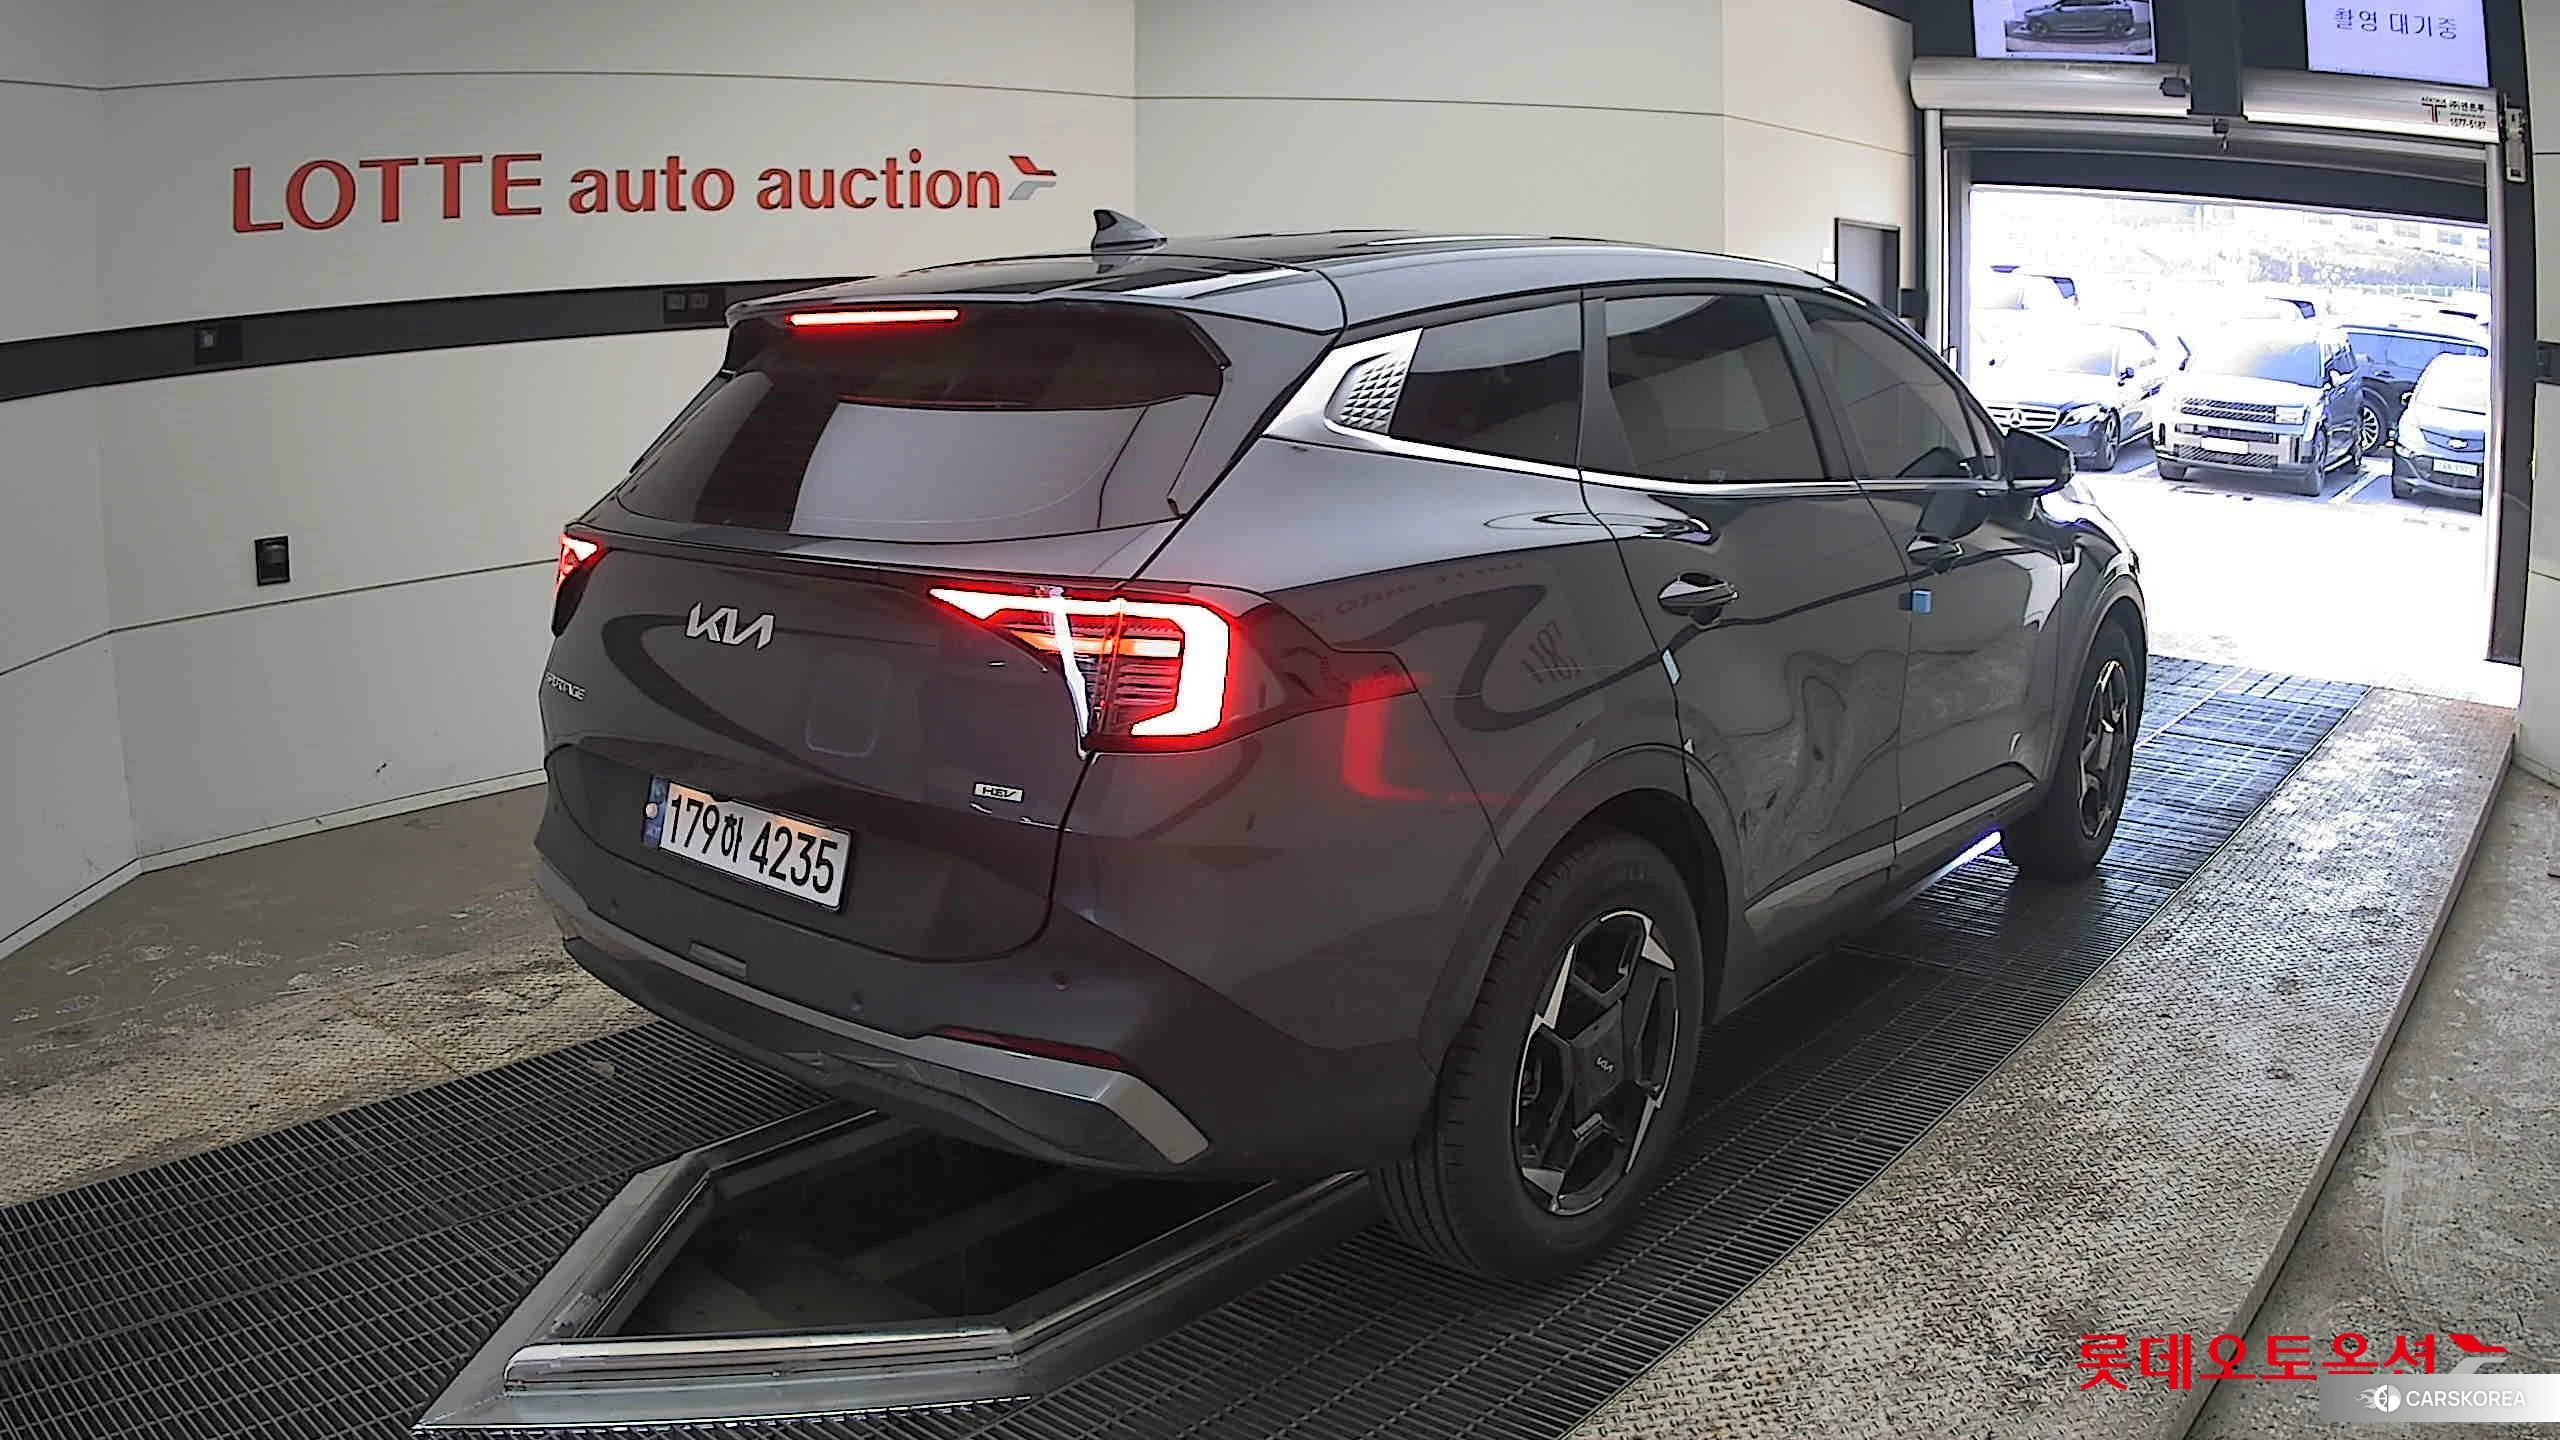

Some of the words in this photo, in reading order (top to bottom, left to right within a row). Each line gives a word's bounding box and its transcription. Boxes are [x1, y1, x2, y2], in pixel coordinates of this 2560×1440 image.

[2335, 7, 2377, 32] 촬영
[233, 153, 542, 233] LOTTE
[568, 155, 735, 214] auto
[757, 148, 1001, 210] auction
[686, 602, 774, 649] KIA
[671, 794, 744, 864] 179하
[749, 821, 838, 894] 4235
